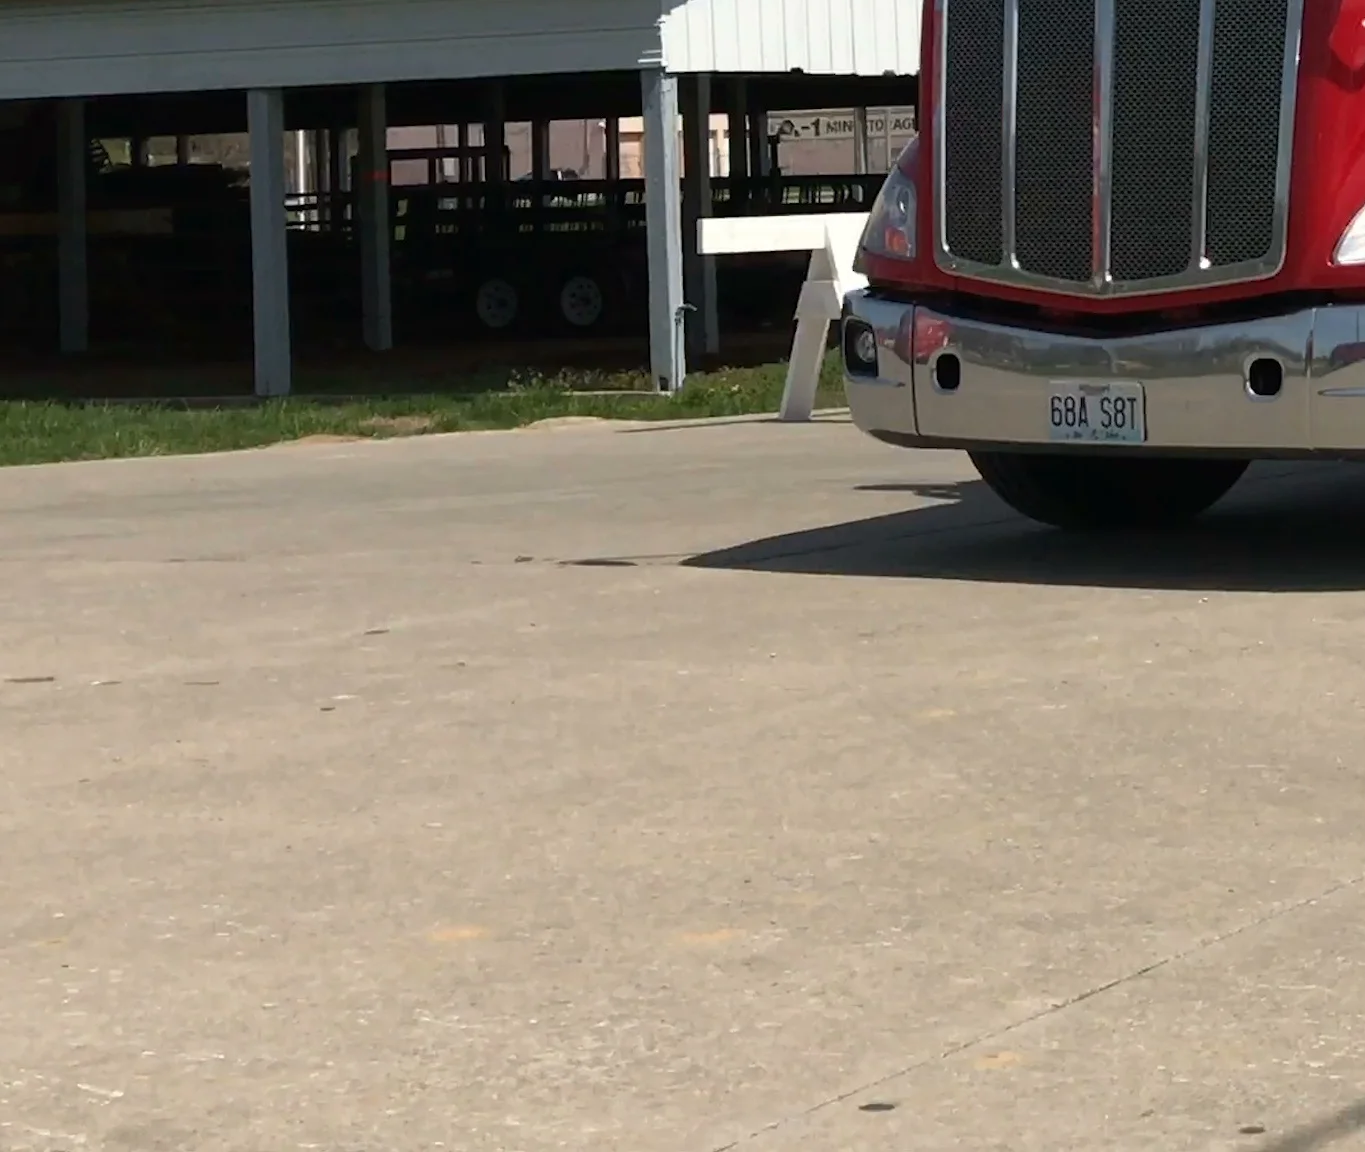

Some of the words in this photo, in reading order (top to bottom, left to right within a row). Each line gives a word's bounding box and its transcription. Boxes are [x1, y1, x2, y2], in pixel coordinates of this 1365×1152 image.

[825, 119, 856, 134] MIN
[1051, 395, 1089, 428] 68A
[1100, 396, 1137, 431] S8T
